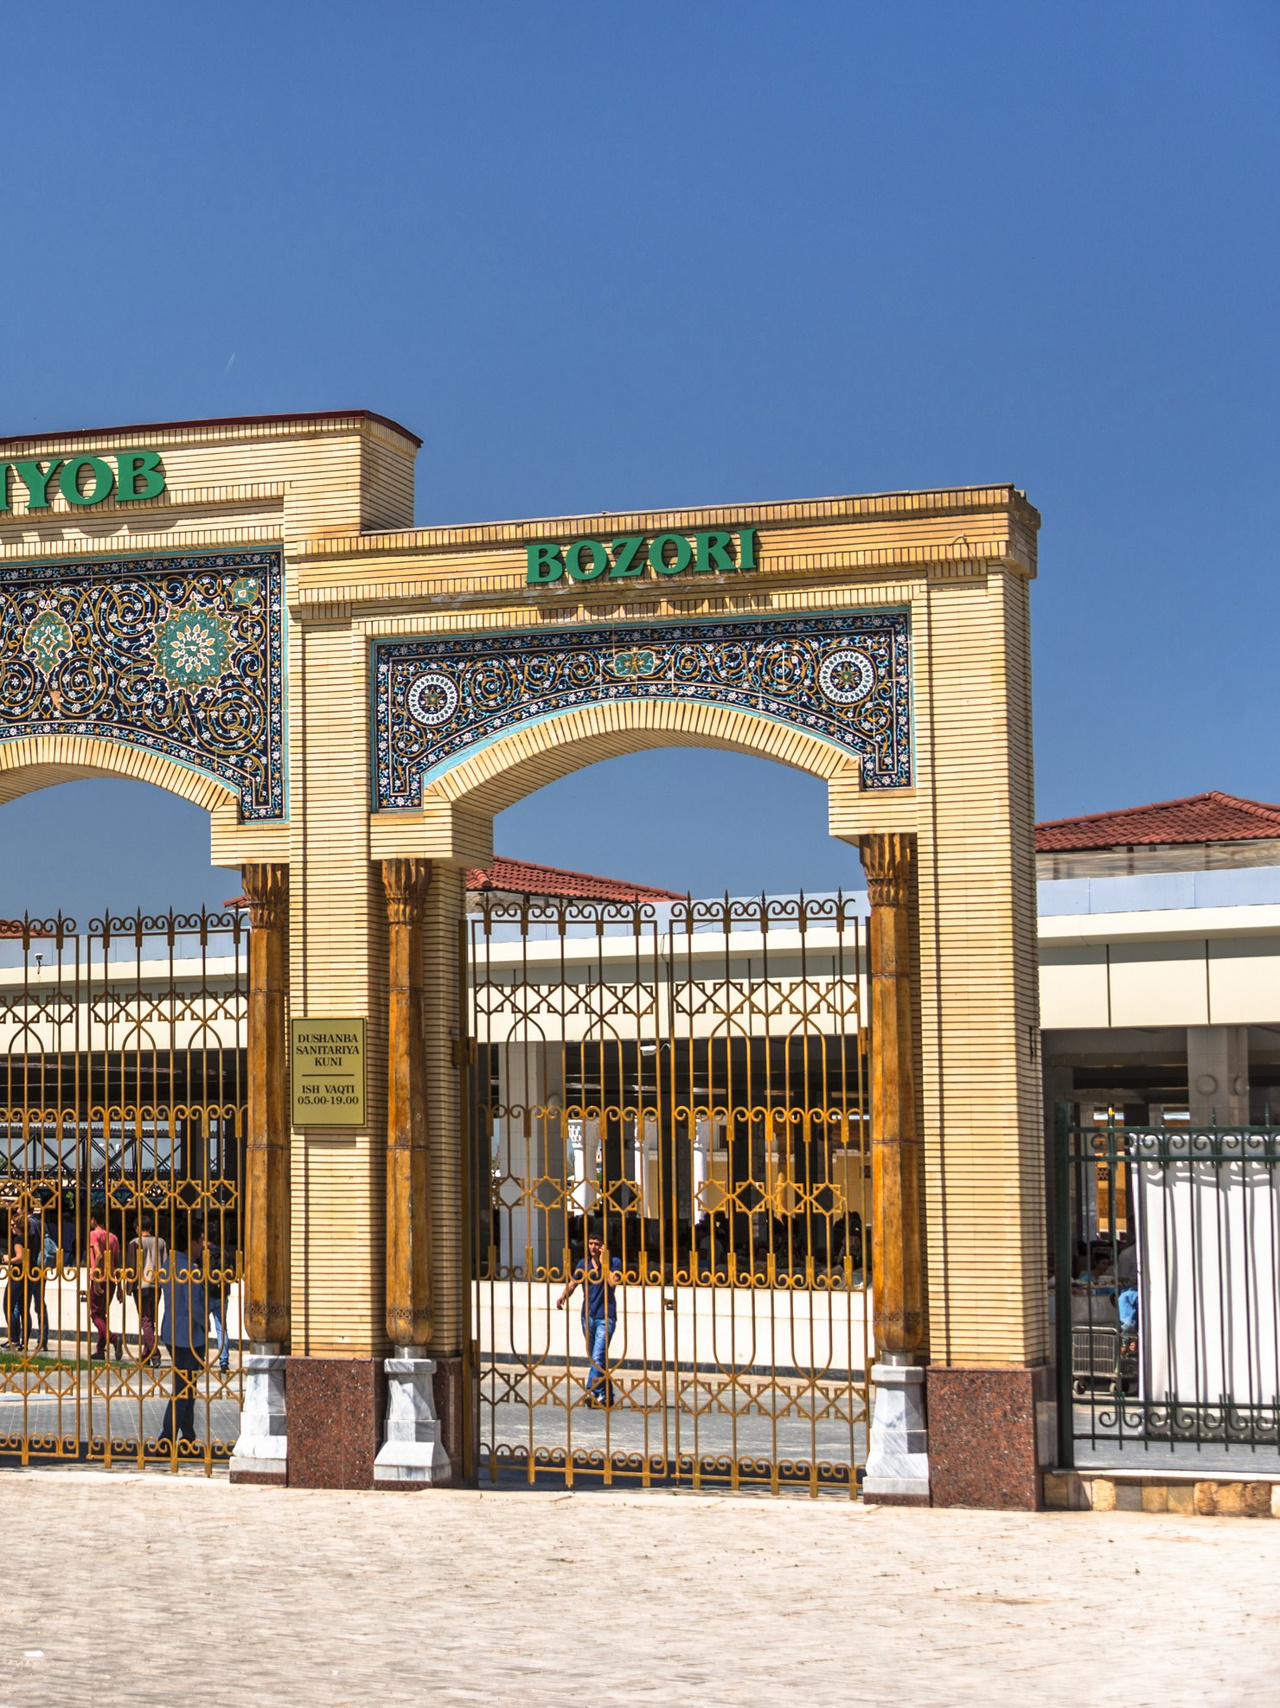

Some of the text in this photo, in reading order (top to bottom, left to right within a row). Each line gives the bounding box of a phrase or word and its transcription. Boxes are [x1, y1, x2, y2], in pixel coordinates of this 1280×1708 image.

[524, 528, 757, 584] BOZORI
[297, 1033, 359, 1043] DUSHANBA
[296, 1045, 360, 1055] SANITARIYA
[314, 1056, 342, 1067] KUNI
[302, 1084, 355, 1095] ISH VAQTI
[297, 1095, 359, 1105] 05.00-19.00
